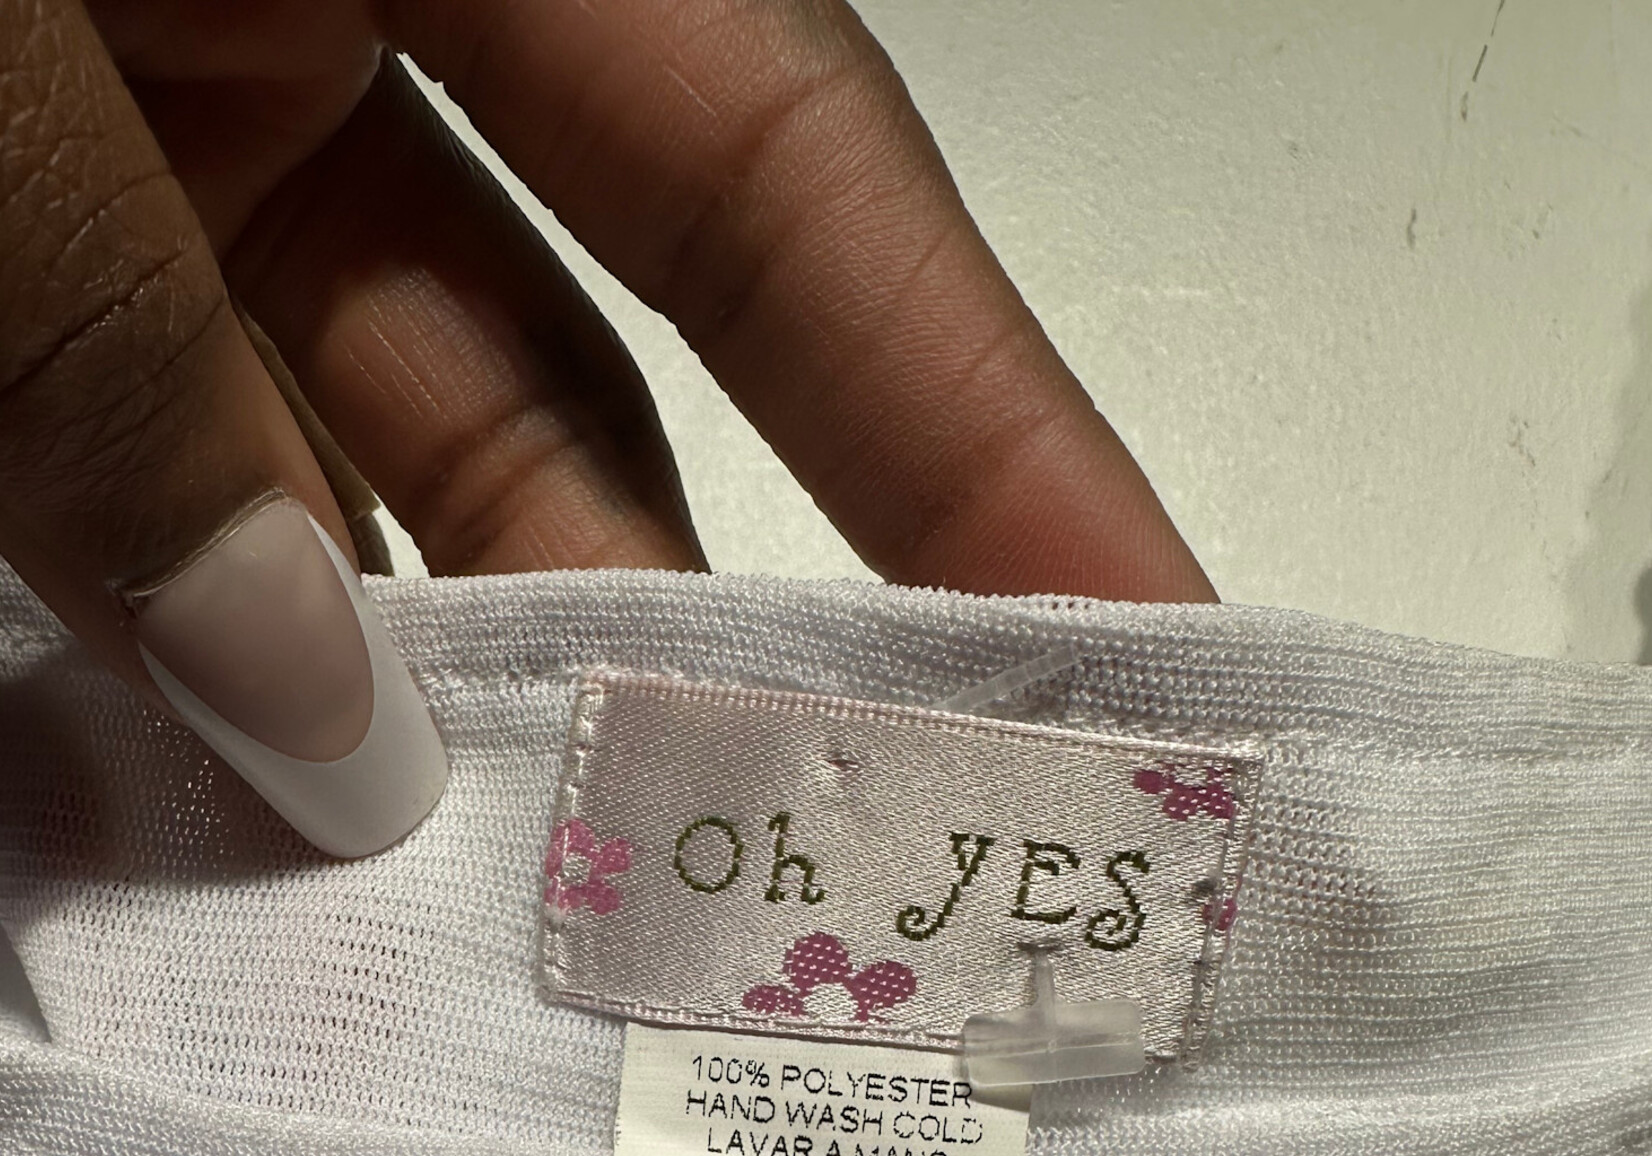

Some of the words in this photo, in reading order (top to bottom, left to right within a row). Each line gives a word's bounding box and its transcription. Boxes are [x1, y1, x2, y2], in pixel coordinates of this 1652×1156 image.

[673, 811, 825, 904] Oh
[692, 1055, 770, 1089] 100%
[781, 1065, 973, 1109] POLYESTER
[686, 1089, 776, 1124] HAND
[786, 1102, 883, 1136] WASH
[893, 1111, 983, 1145] COLD
